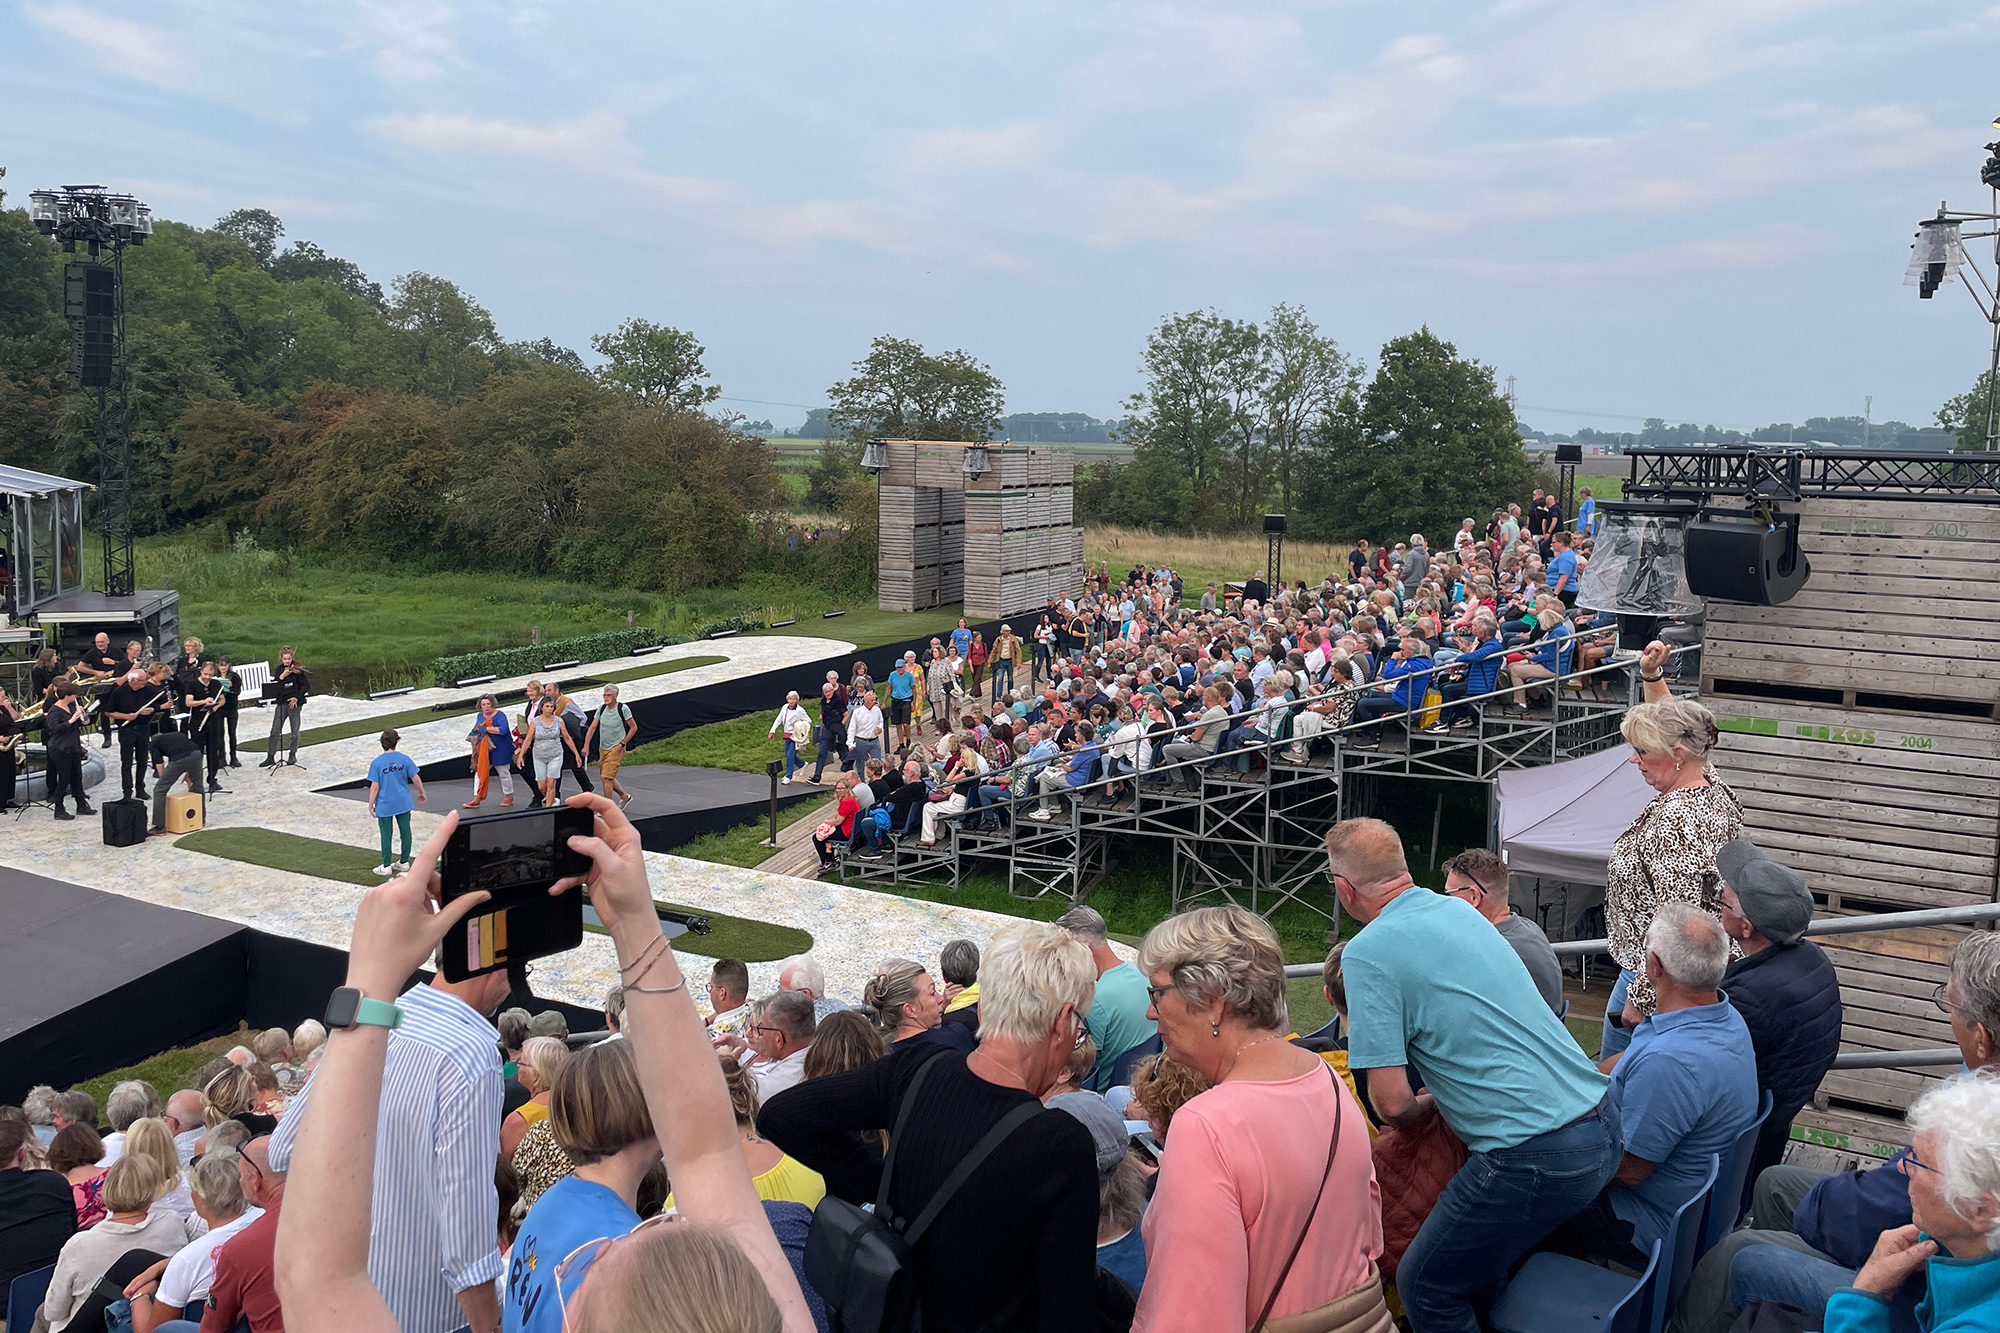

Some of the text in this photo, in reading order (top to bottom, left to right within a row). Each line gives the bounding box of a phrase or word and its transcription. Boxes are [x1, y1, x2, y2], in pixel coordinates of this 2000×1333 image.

[1925, 522, 1969, 538] 2005
[1900, 735, 1933, 750] 2004
[383, 764, 405, 775] CREW
